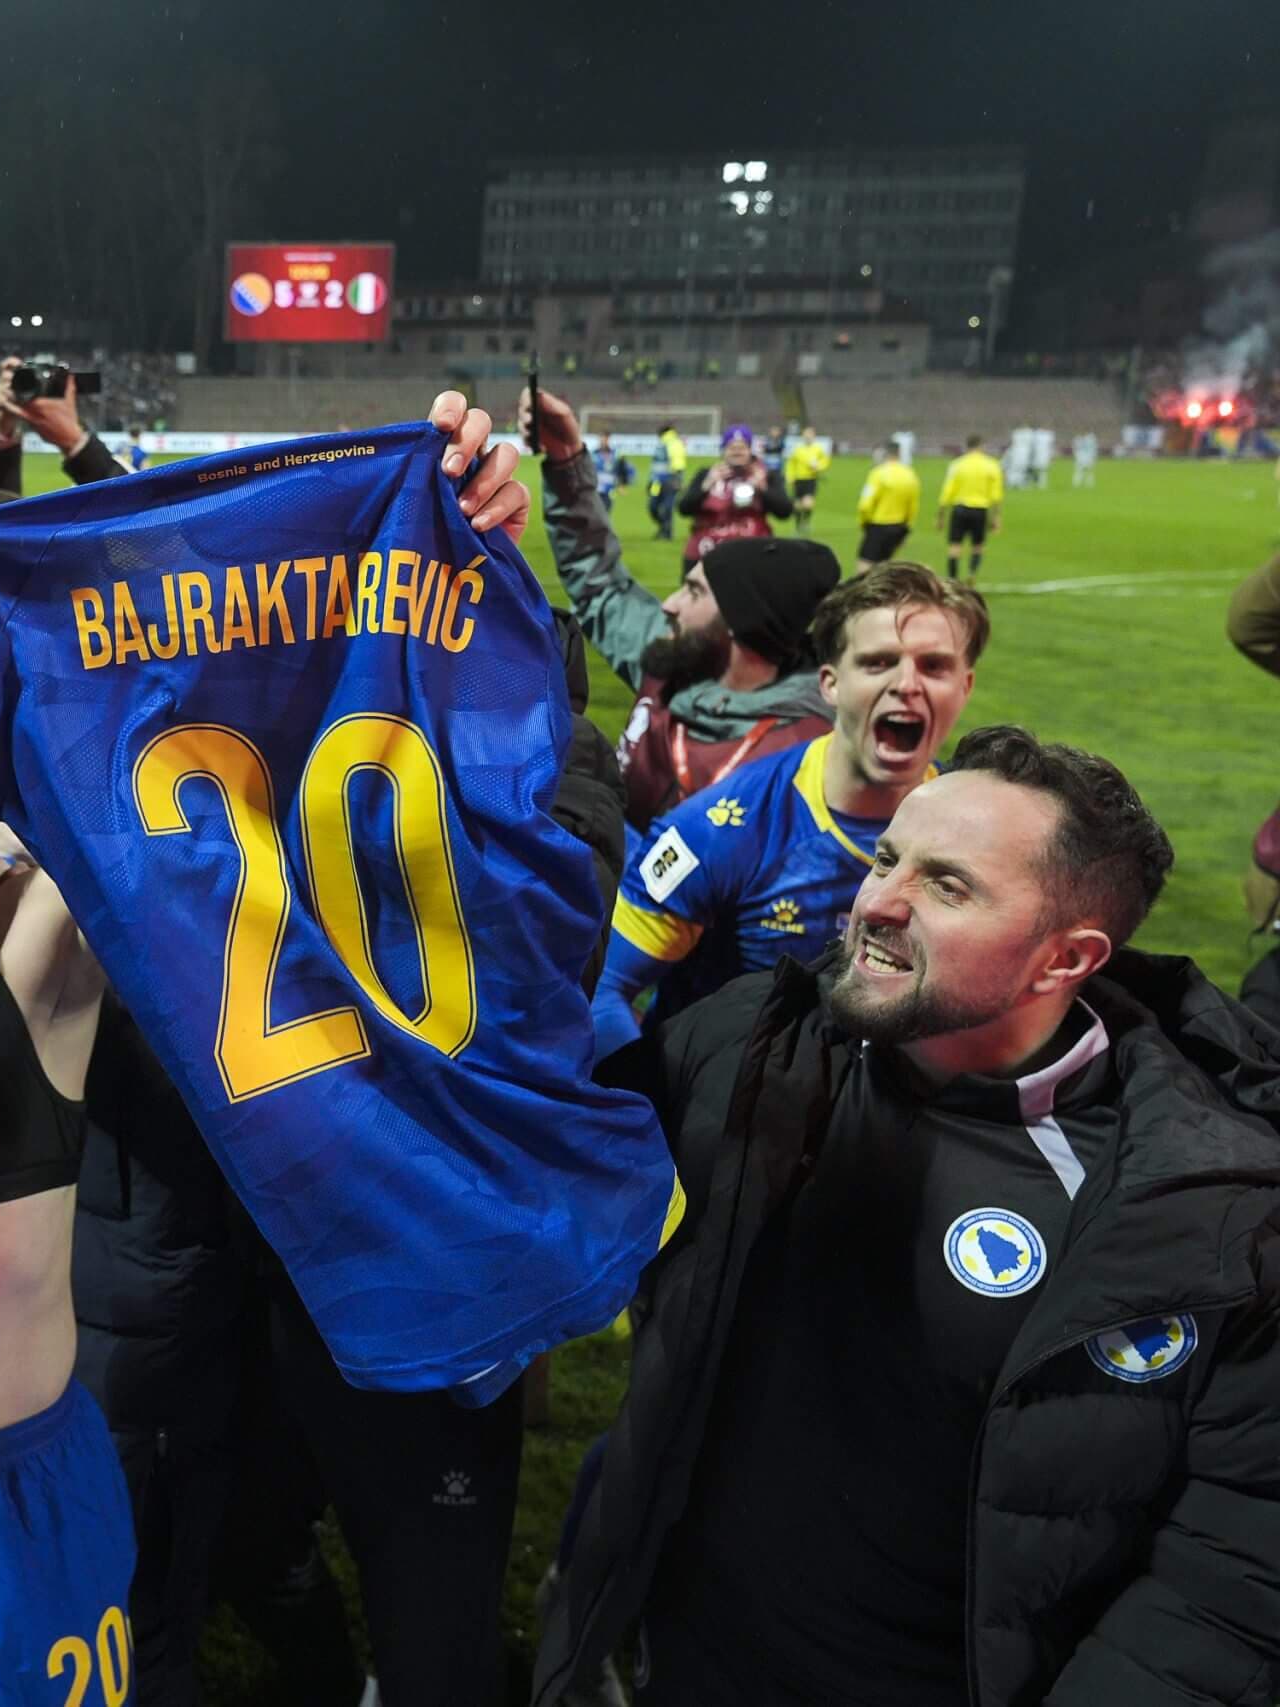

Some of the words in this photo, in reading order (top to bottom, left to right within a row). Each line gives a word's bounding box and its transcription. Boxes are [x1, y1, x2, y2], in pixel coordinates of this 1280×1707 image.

[197, 464, 248, 484] Bosnia
[253, 456, 281, 473] and
[284, 444, 376, 467] Herzegovina
[70, 549, 488, 670] BAJRAKTAREVIĆ
[132, 711, 478, 1105] 20
[46, 1605, 130, 1707] 20
